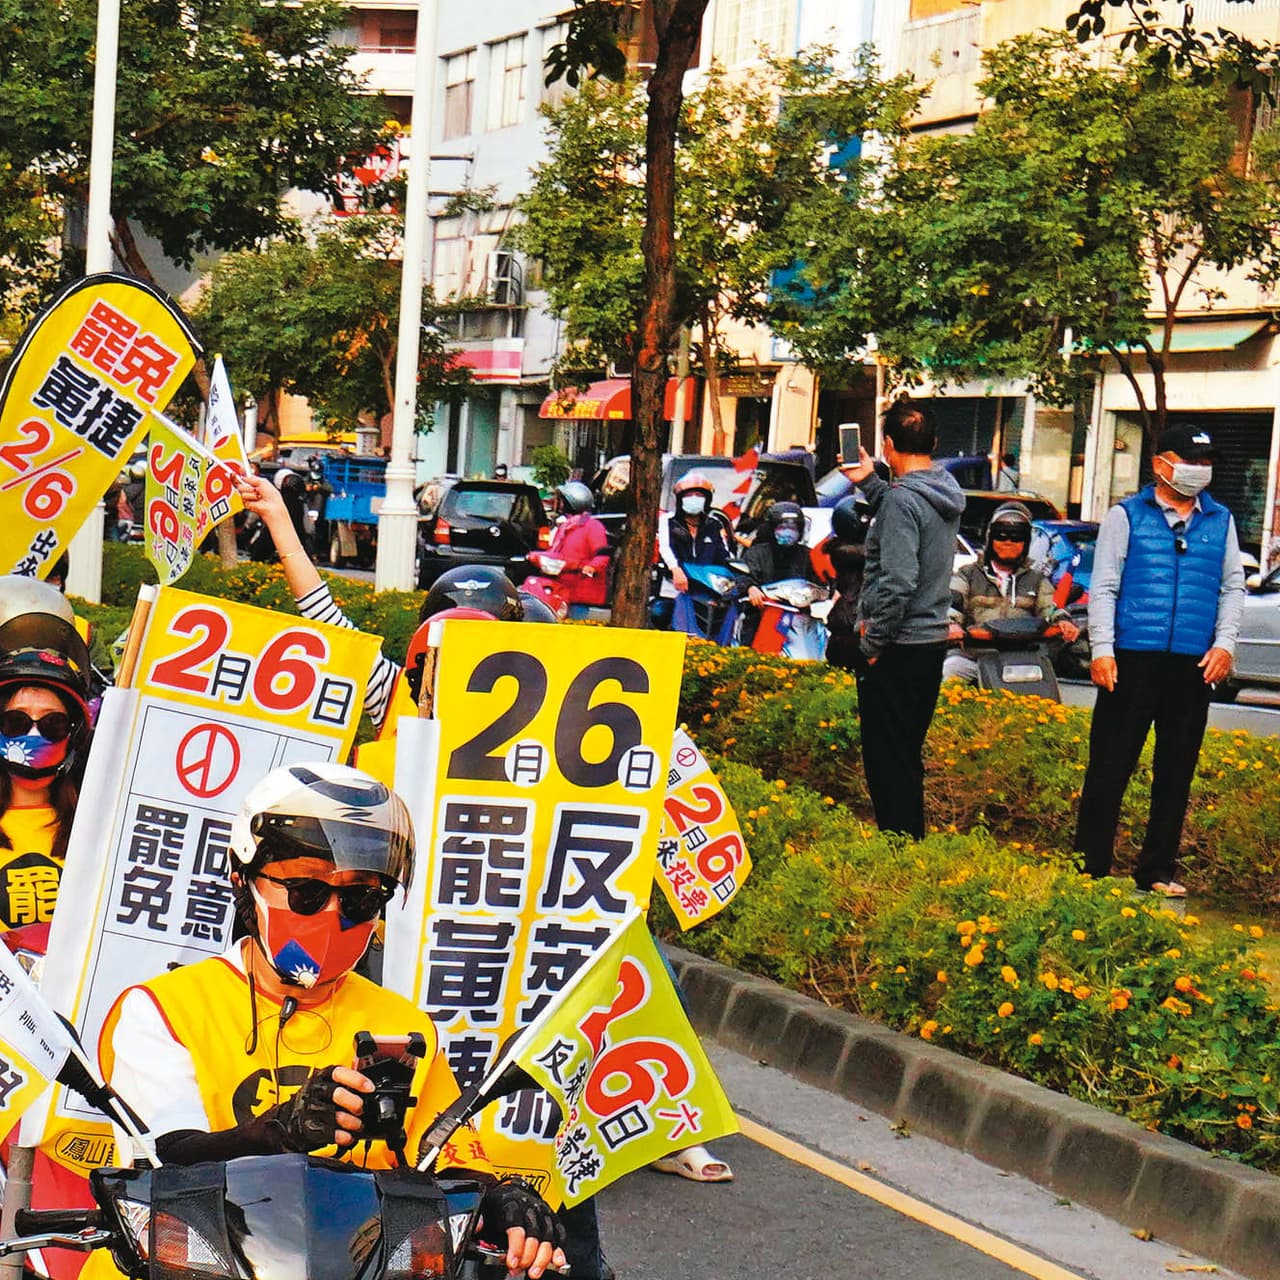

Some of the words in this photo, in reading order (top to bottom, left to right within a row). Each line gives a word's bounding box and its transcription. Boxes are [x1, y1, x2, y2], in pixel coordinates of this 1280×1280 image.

[68, 299, 181, 404] 罷免
[32, 355, 147, 459] 黃捷
[151, 606, 359, 726] 2月6日
[444, 650, 661, 792] 2月6日
[5, 866, 62, 924] 罷
[116, 803, 188, 933] 罷免
[657, 838, 710, 917] 來投票
[664, 786, 743, 902] 2月6日
[659, 1103, 699, 1138] 六
